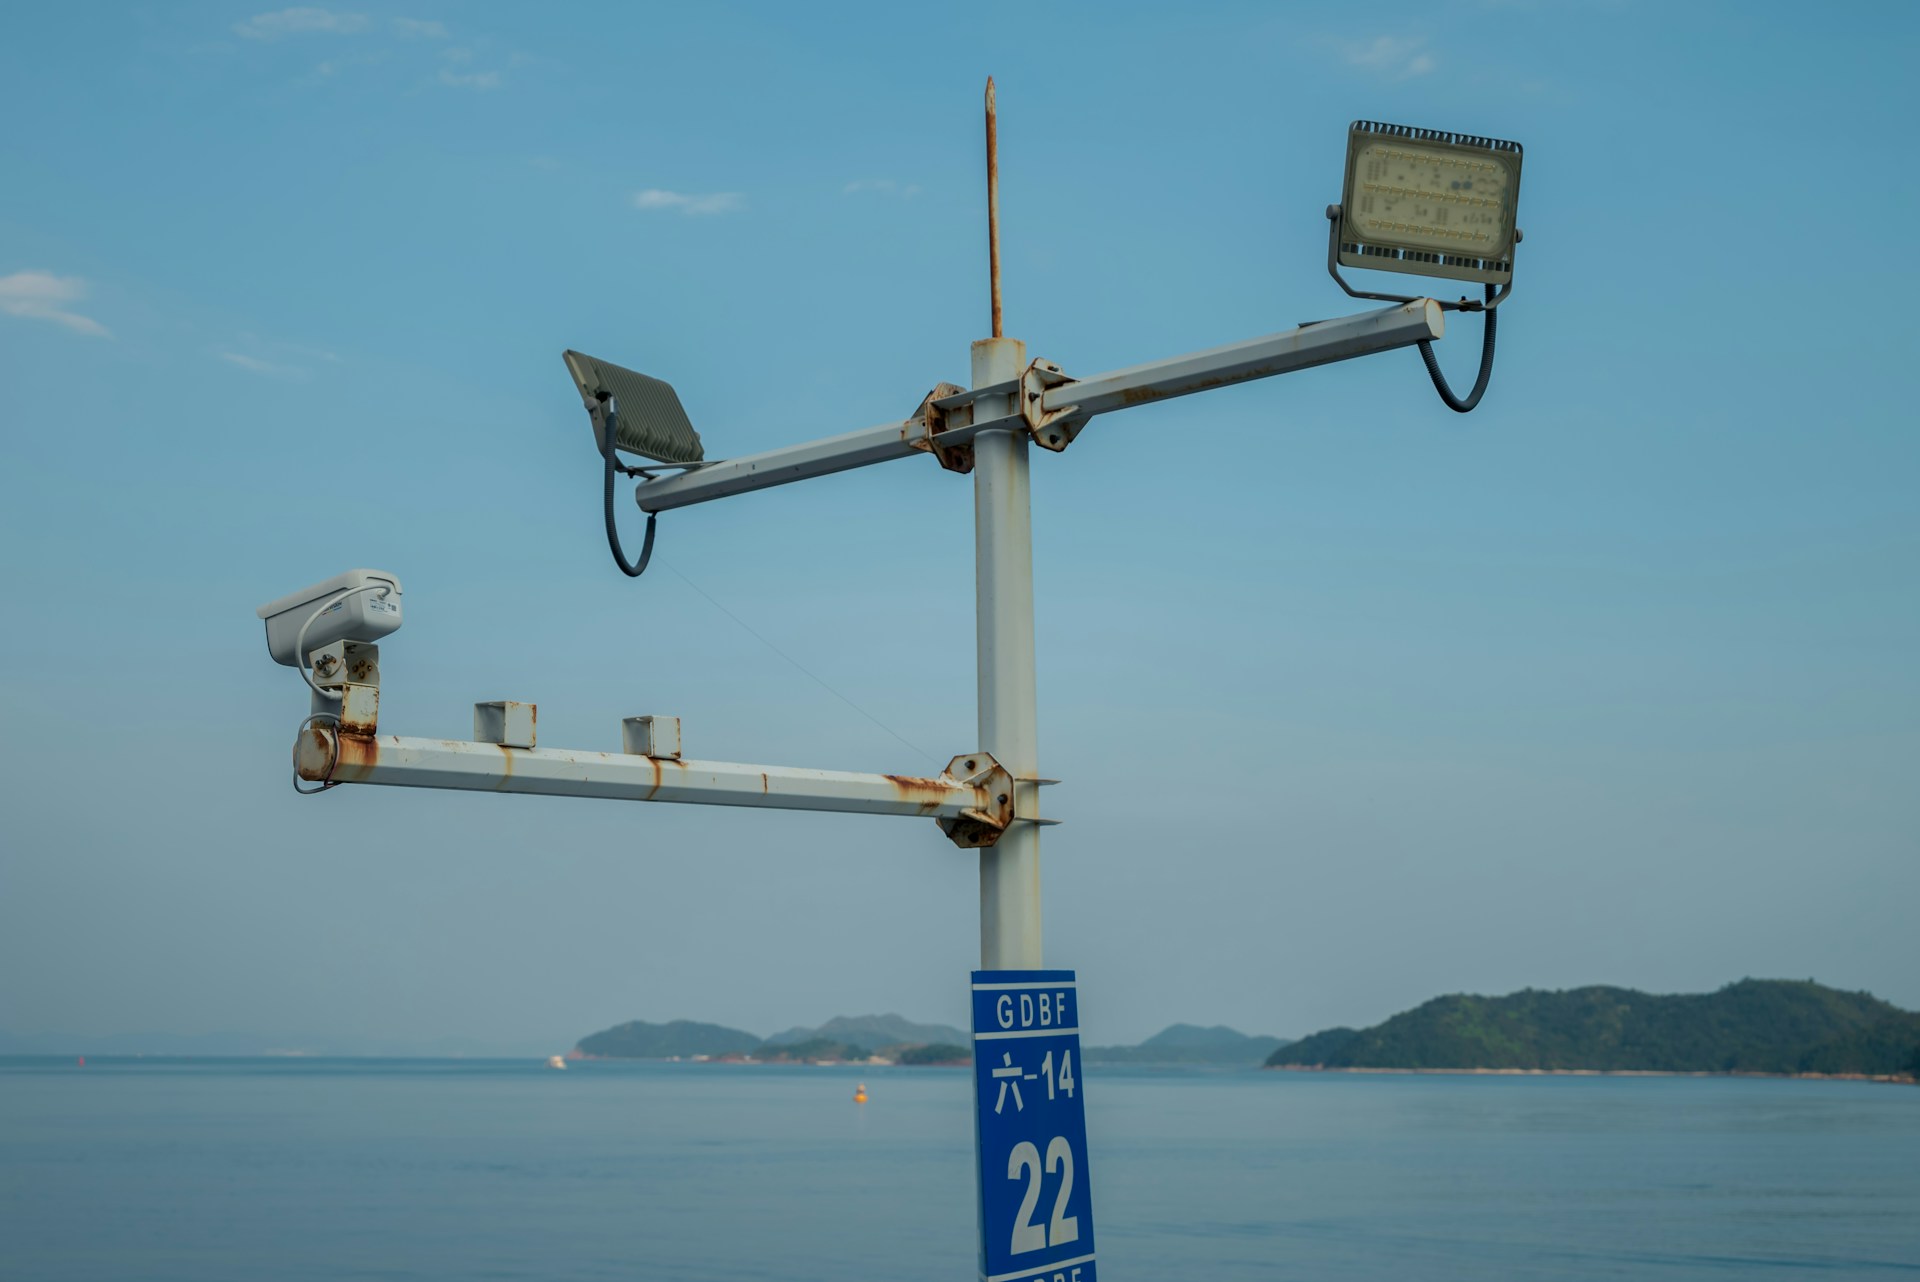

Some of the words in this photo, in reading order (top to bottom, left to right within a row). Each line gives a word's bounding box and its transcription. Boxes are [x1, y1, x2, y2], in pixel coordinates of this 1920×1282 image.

[996, 993, 1065, 1029] GDBF
[992, 1050, 1075, 1115] 六-14
[1007, 1136, 1079, 1255] 22
